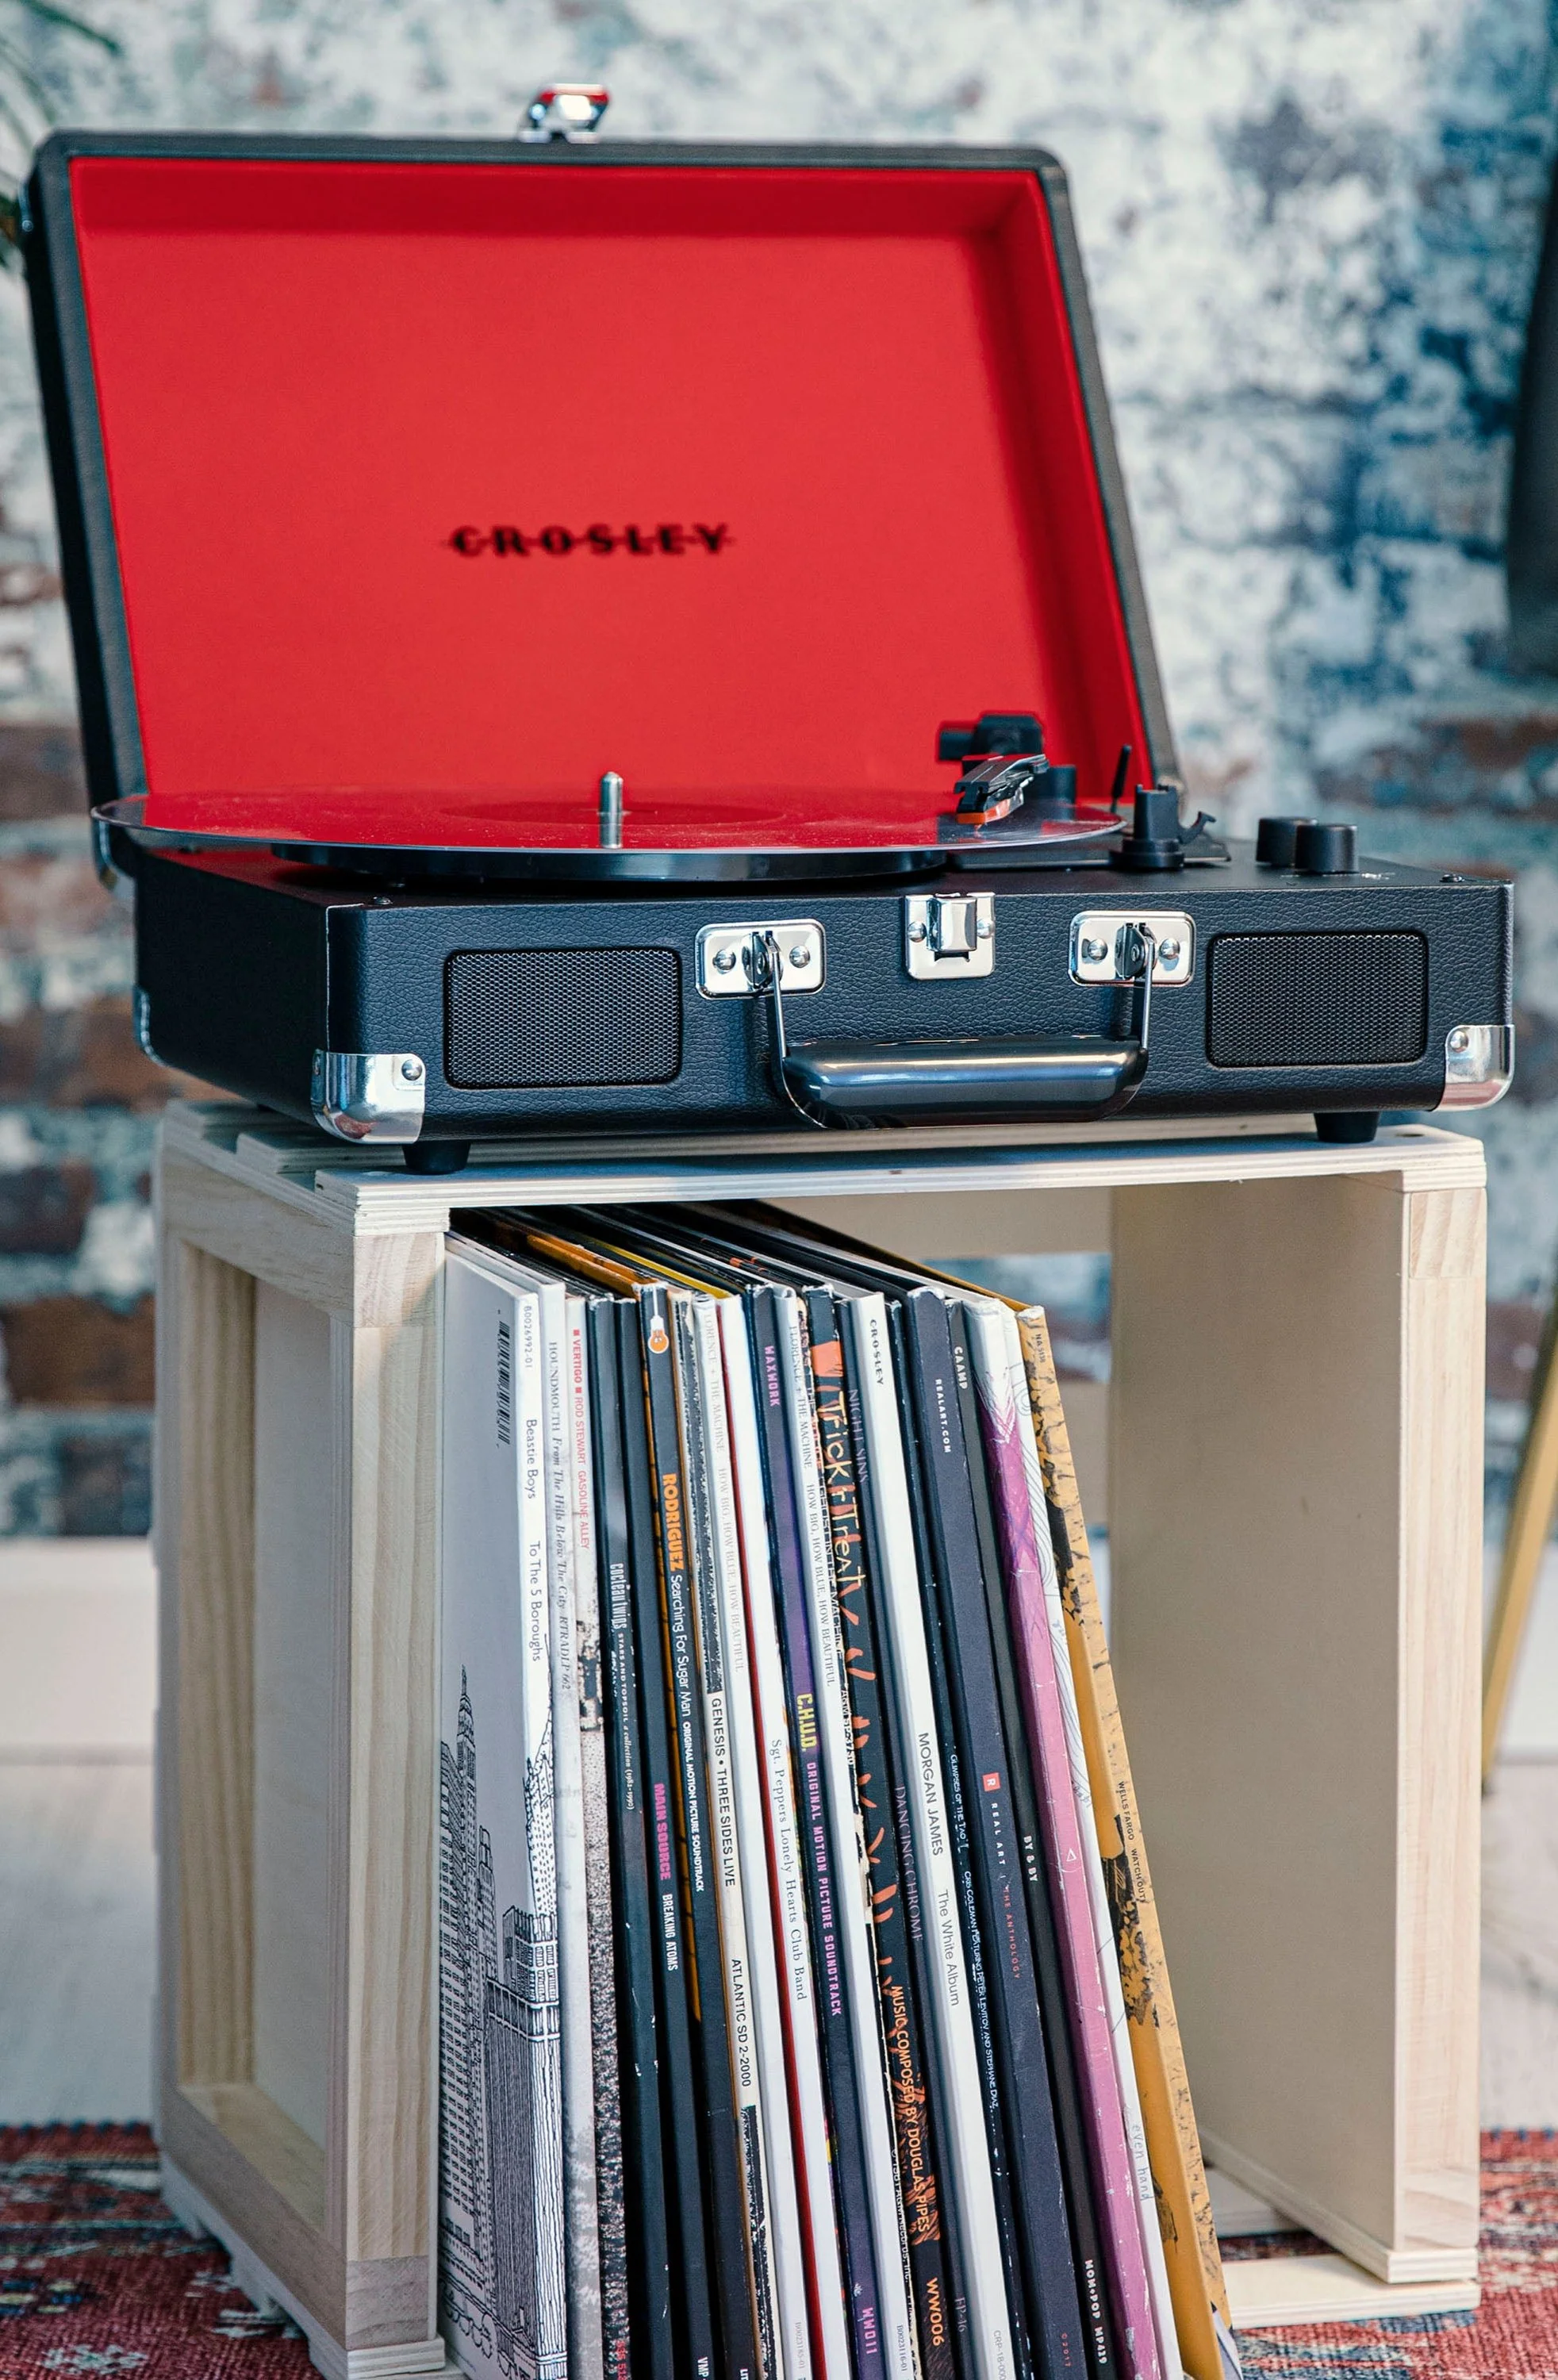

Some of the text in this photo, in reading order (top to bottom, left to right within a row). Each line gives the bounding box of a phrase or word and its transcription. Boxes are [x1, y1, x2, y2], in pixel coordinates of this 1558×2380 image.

[446, 522, 731, 557] CROSLEY
[704, 1311, 716, 1363] LORENCE
[789, 1326, 803, 1383] FLORENCE
[871, 1319, 883, 1384] CROSLEY
[549, 1342, 560, 1430] HOUNDMOUTH
[711, 1380, 720, 1399] THE
[765, 1345, 780, 1407] WAXWORK
[954, 1346, 967, 1388] CAAMP
[712, 1404, 724, 1452] MACHINE
[798, 1398, 807, 1417] THE
[935, 1379, 951, 1453] REALART.COM
[527, 1419, 537, 1464] Beastie
[553, 1437, 562, 1465] From
[800, 1421, 812, 1468] MACHINE
[849, 1388, 868, 1484] NIGHT SINS
[525, 1469, 539, 1499] Boys
[554, 1470, 563, 1490] The
[574, 1397, 589, 1549] ROD STEWART GASOLINE ALLEY
[719, 1468, 728, 1492] HOW
[555, 1495, 565, 1520] Hills
[721, 1497, 730, 1519] BIG,
[807, 1484, 816, 1509] HOW
[556, 1525, 565, 1557] Below
[723, 1522, 733, 1547] HOW
[810, 1513, 819, 1534] BIG,
[530, 1541, 540, 1557] To
[531, 1559, 541, 1583] The
[558, 1561, 566, 1581] The
[726, 1551, 735, 1580] BLUE,
[813, 1538, 822, 1563] HOW
[610, 1563, 626, 1601] cocteau
[662, 1472, 691, 1717] RODRIGUEZ Searching For Sugar Man
[729, 1585, 738, 1610] HOW
[815, 1566, 825, 1596] BLUE,
[529, 1601, 543, 1661] Boroughs
[819, 1600, 828, 1625] HOW
[560, 1615, 570, 1671] RTRADLP
[731, 1614, 743, 1672] BEAUTIFUL
[822, 1629, 835, 1686] BEAUTIFUL
[797, 1693, 816, 1752] C.H.U.D.
[625, 1769, 634, 1810] (1982-1990)
[712, 1699, 735, 1887] GENESIS THREE SIDES LIVE
[919, 1733, 943, 1856] MORGAN JAMES
[951, 1754, 961, 1792] GLIMPSES
[683, 1722, 704, 1891] ORIGINAL MOTION PICTURE SOUNDTRACK
[1118, 1781, 1128, 1810] WELLS
[1124, 1811, 1134, 1840] FARGO
[1131, 1848, 1143, 1879] WATCH
[654, 1783, 678, 1971] MAIN SOURCE BREAKING ATOMS
[769, 1739, 807, 2000] Sgt. Peppers Lonely Hearts Club Band
[896, 1786, 923, 1941] DANCING CHROME
[1024, 1835, 1033, 1850] BY
[1029, 1868, 1038, 1882] BY
[807, 1762, 841, 2016] ORIGINAL MOTION PICTURE SOUNDTRACK
[966, 1889, 977, 1928] COLEMAN
[992, 1802, 1000, 1835] REAL
[1007, 1914, 1019, 1979] ANTHOLOGY
[938, 1889, 959, 2006] The White Album
[971, 1929, 983, 1971] FEATURING
[977, 1971, 985, 1994] PETER
[732, 1959, 750, 2086] ATLANTIC SD 2-2000
[985, 2048, 996, 2089] STEPHANE
[890, 1986, 929, 2232] MUSIC COMPOSED BY DOUGLAS PIPES
[990, 2089, 999, 2109] DIAZ
[1132, 2125, 1155, 2202] even hand
[927, 2277, 944, 2346] WW006
[698, 2356, 708, 2377] VMP
